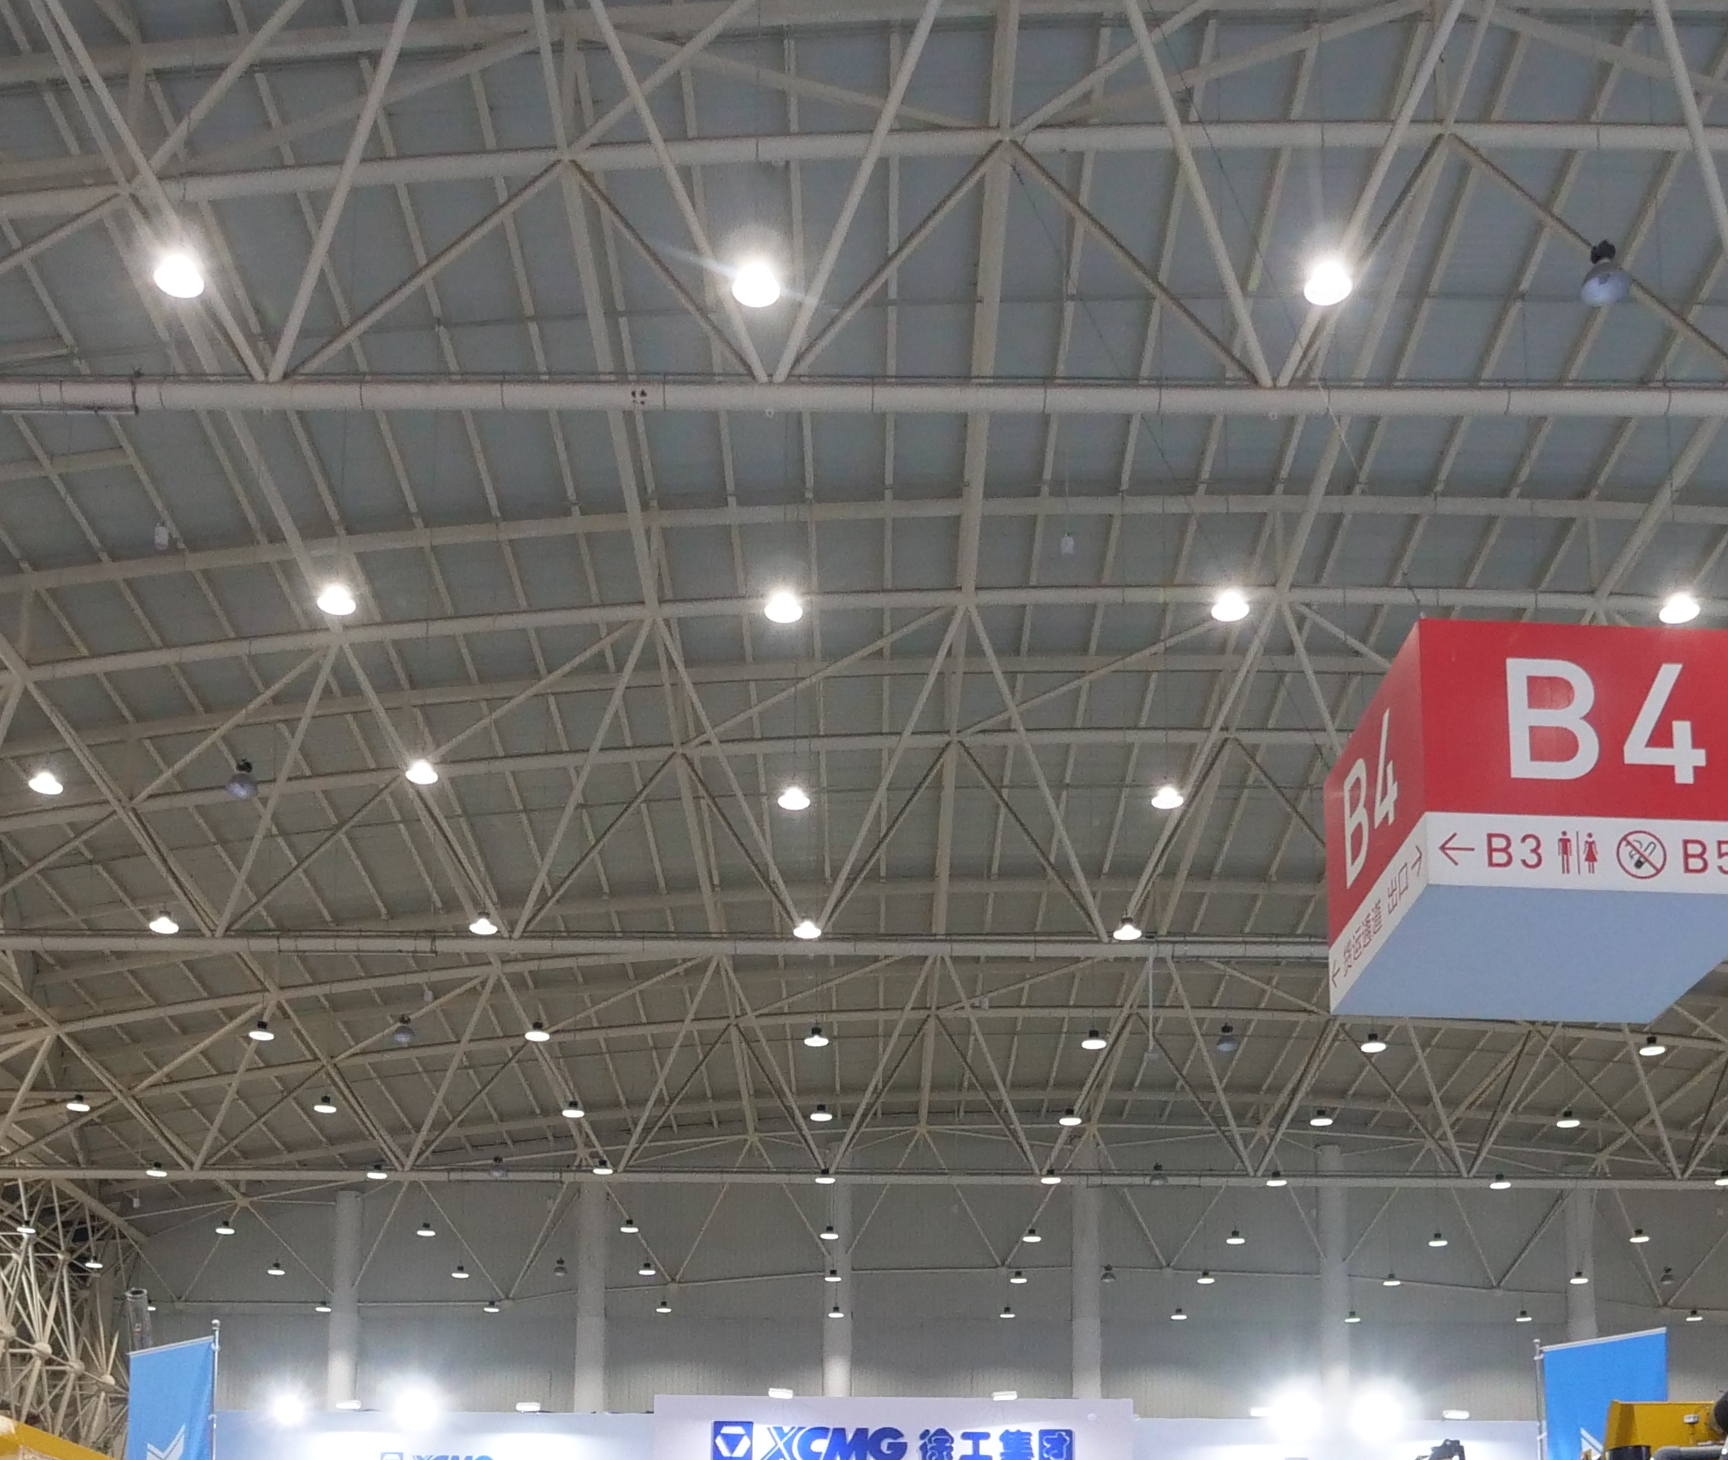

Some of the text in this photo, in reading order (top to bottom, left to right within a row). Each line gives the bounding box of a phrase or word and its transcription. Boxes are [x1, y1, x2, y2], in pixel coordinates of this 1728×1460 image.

[1505, 657, 1707, 785] B4
[1342, 708, 1399, 890] B4
[1387, 861, 1409, 915] 出口
[1486, 832, 1544, 869] B3
